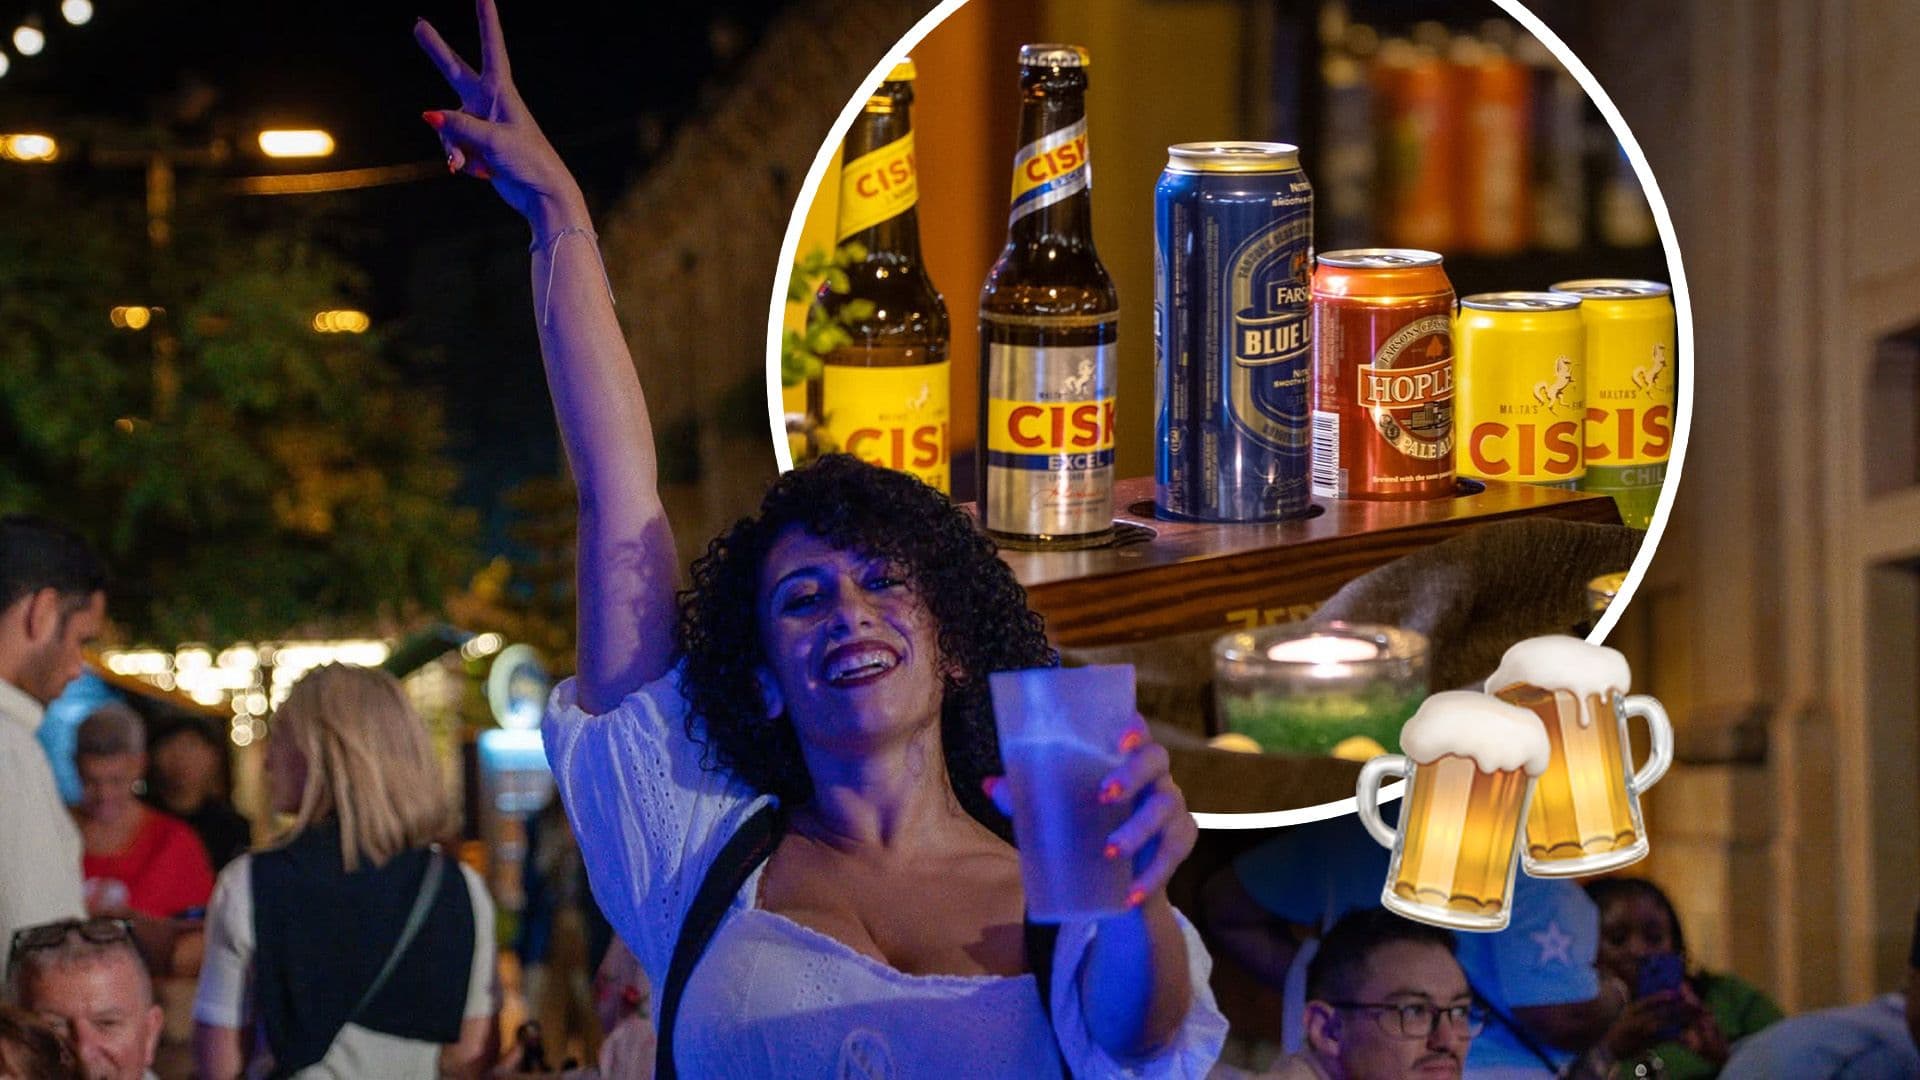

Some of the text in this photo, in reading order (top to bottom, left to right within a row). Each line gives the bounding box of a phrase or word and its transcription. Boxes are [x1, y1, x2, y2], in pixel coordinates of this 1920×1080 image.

[1245, 323, 1299, 356] BLUE
[1380, 325, 1420, 364] FARSONS
[1049, 453, 1105, 470] EXCEL
[1399, 437, 1437, 459] PALE
